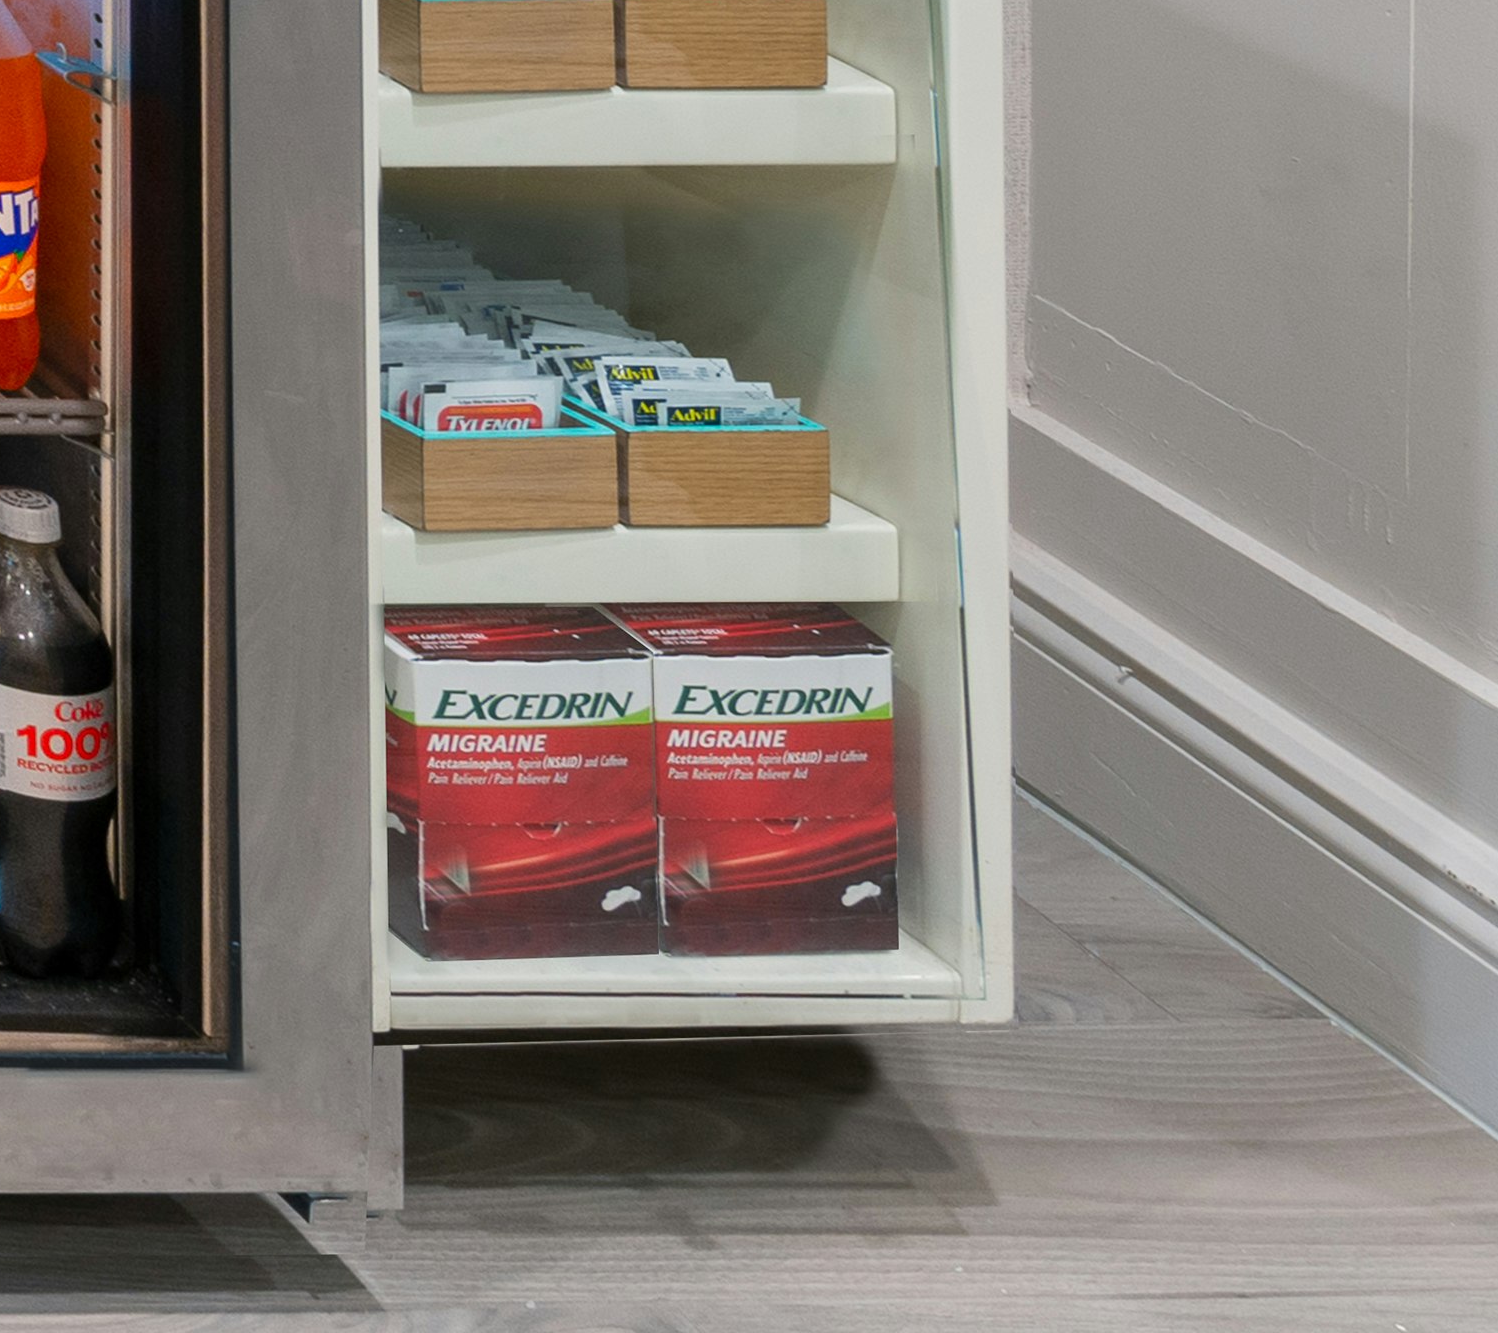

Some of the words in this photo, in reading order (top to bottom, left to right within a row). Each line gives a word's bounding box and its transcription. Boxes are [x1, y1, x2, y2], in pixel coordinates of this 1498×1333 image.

[433, 690, 633, 720] EXCEDRIN
[672, 685, 873, 715] EXCEDRIN
[427, 757, 514, 770] Acetaminophen,
[543, 754, 582, 769] (NSAID)
[428, 773, 448, 783] Pain
[553, 773, 568, 783] Aid
